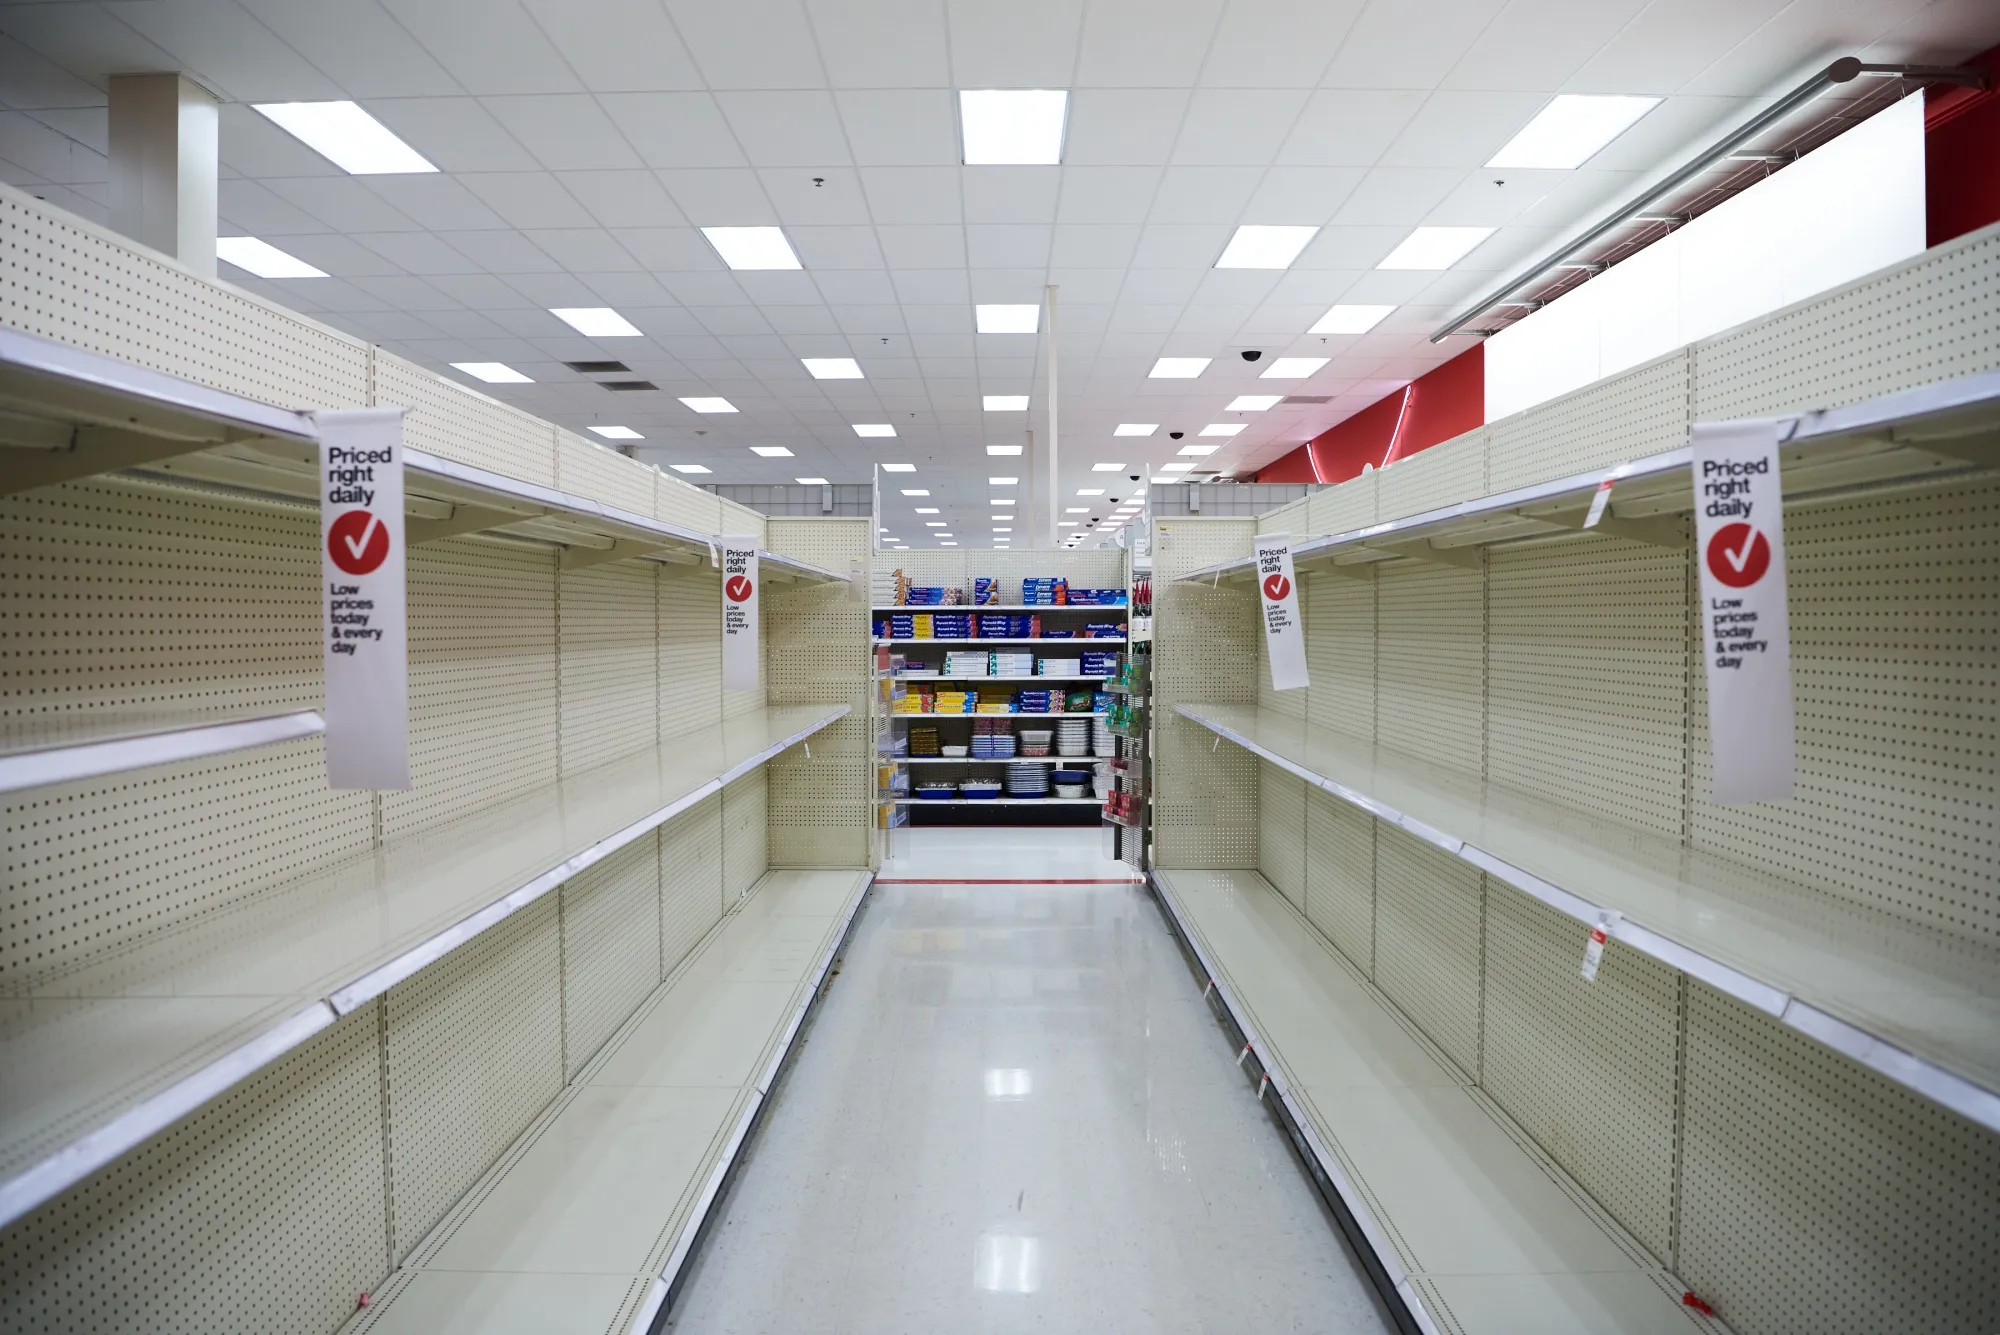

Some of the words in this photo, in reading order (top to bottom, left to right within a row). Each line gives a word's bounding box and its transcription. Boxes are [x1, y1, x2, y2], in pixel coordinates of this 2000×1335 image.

[328, 446, 392, 464] Priced
[1704, 456, 1768, 478] Priced
[328, 466, 374, 486] right
[1704, 478, 1750, 499] right
[328, 486, 374, 506] daily
[1706, 498, 1752, 518] daily
[1260, 547, 1287, 557] Priced
[726, 558, 746, 566] right
[1260, 556, 1280, 566] right
[726, 566, 746, 574] daily
[1262, 564, 1282, 573] daily
[330, 583, 359, 595] Low
[330, 598, 374, 612] prices
[1712, 598, 1742, 610] Low
[330, 612, 370, 626] today
[1714, 611, 1758, 626] prices
[331, 626, 340, 638] &
[344, 629, 383, 641] every
[1714, 626, 1754, 640] today
[331, 641, 356, 656] day
[1716, 641, 1725, 653] &
[1728, 641, 1768, 653] every
[1716, 656, 1743, 670] day
